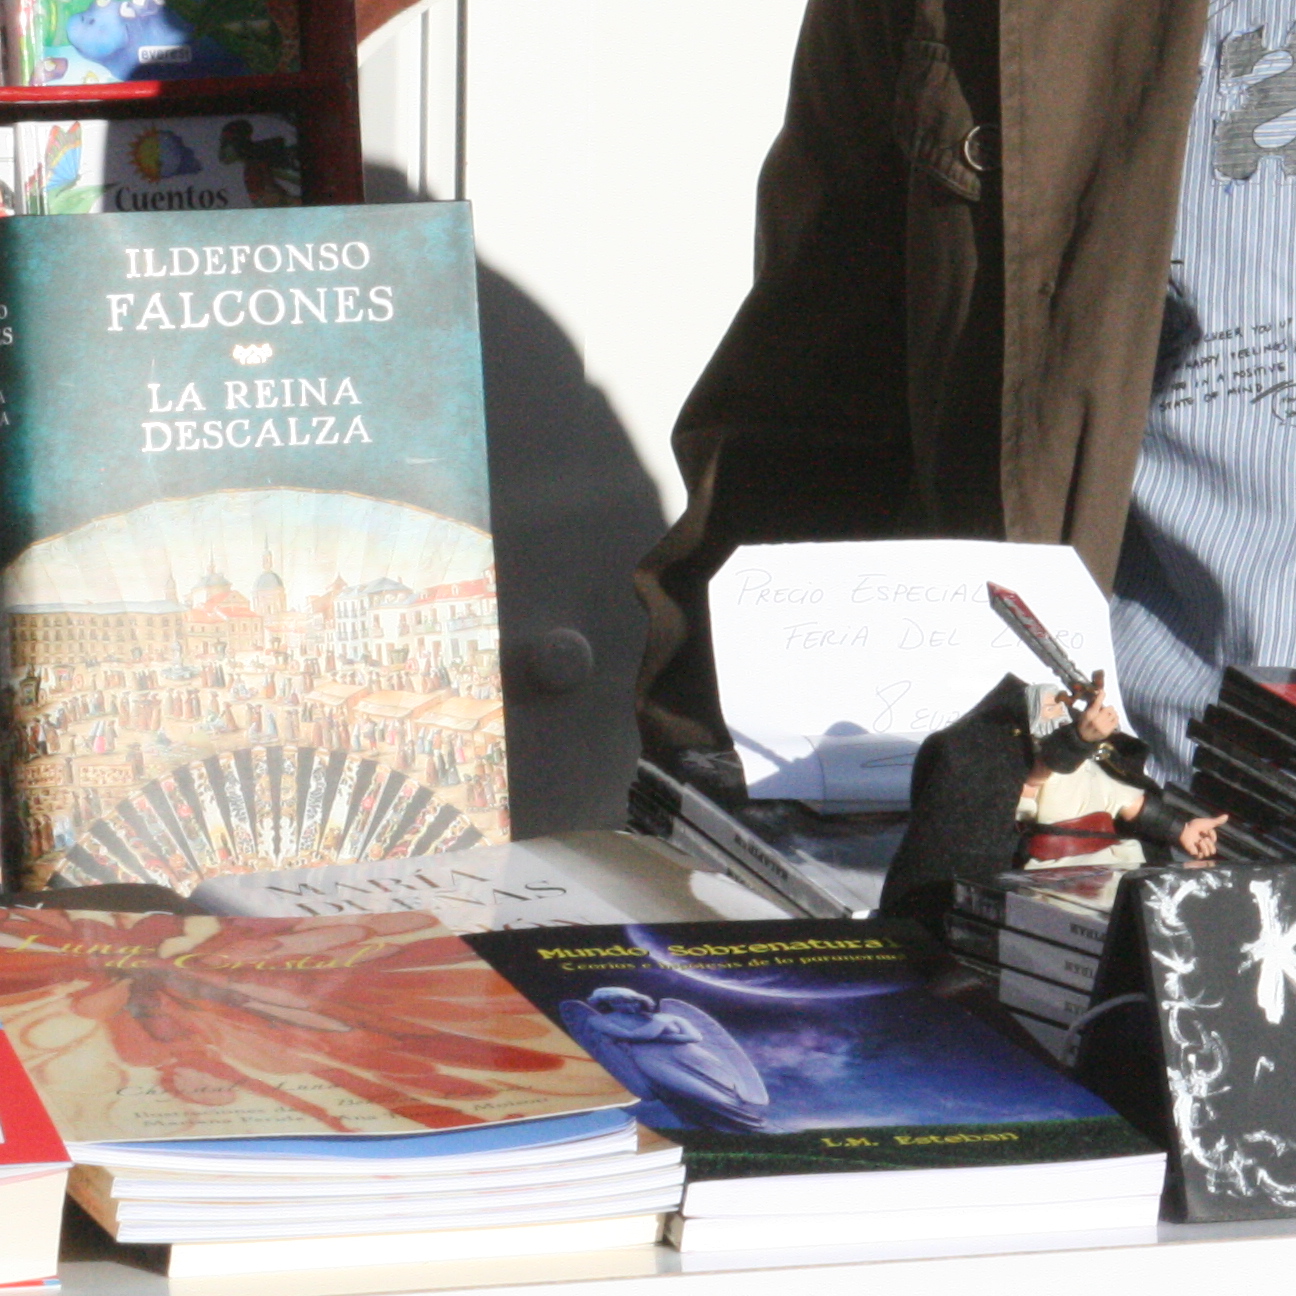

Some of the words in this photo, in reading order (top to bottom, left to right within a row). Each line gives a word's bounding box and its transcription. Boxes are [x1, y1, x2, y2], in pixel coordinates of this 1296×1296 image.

[140, 48, 191, 62] everest
[115, 183, 230, 211] Cuentos
[125, 240, 372, 280] ILDEFONSO
[106, 284, 396, 333] FALCONES
[1251, 323, 1273, 335] YOU
[1232, 361, 1287, 381] POSITIVE
[148, 380, 207, 414] LA
[224, 375, 363, 411] REINA
[1226, 384, 1263, 396] MIND
[141, 412, 374, 454] DESCALZA
[897, 617, 962, 651] DEL
[267, 867, 491, 902] MARÍA
[537, 947, 651, 961] Mundo
[667, 938, 898, 958] Sobrenatural
[748, 956, 771, 969] de
[893, 1128, 1020, 1148] Esteban
